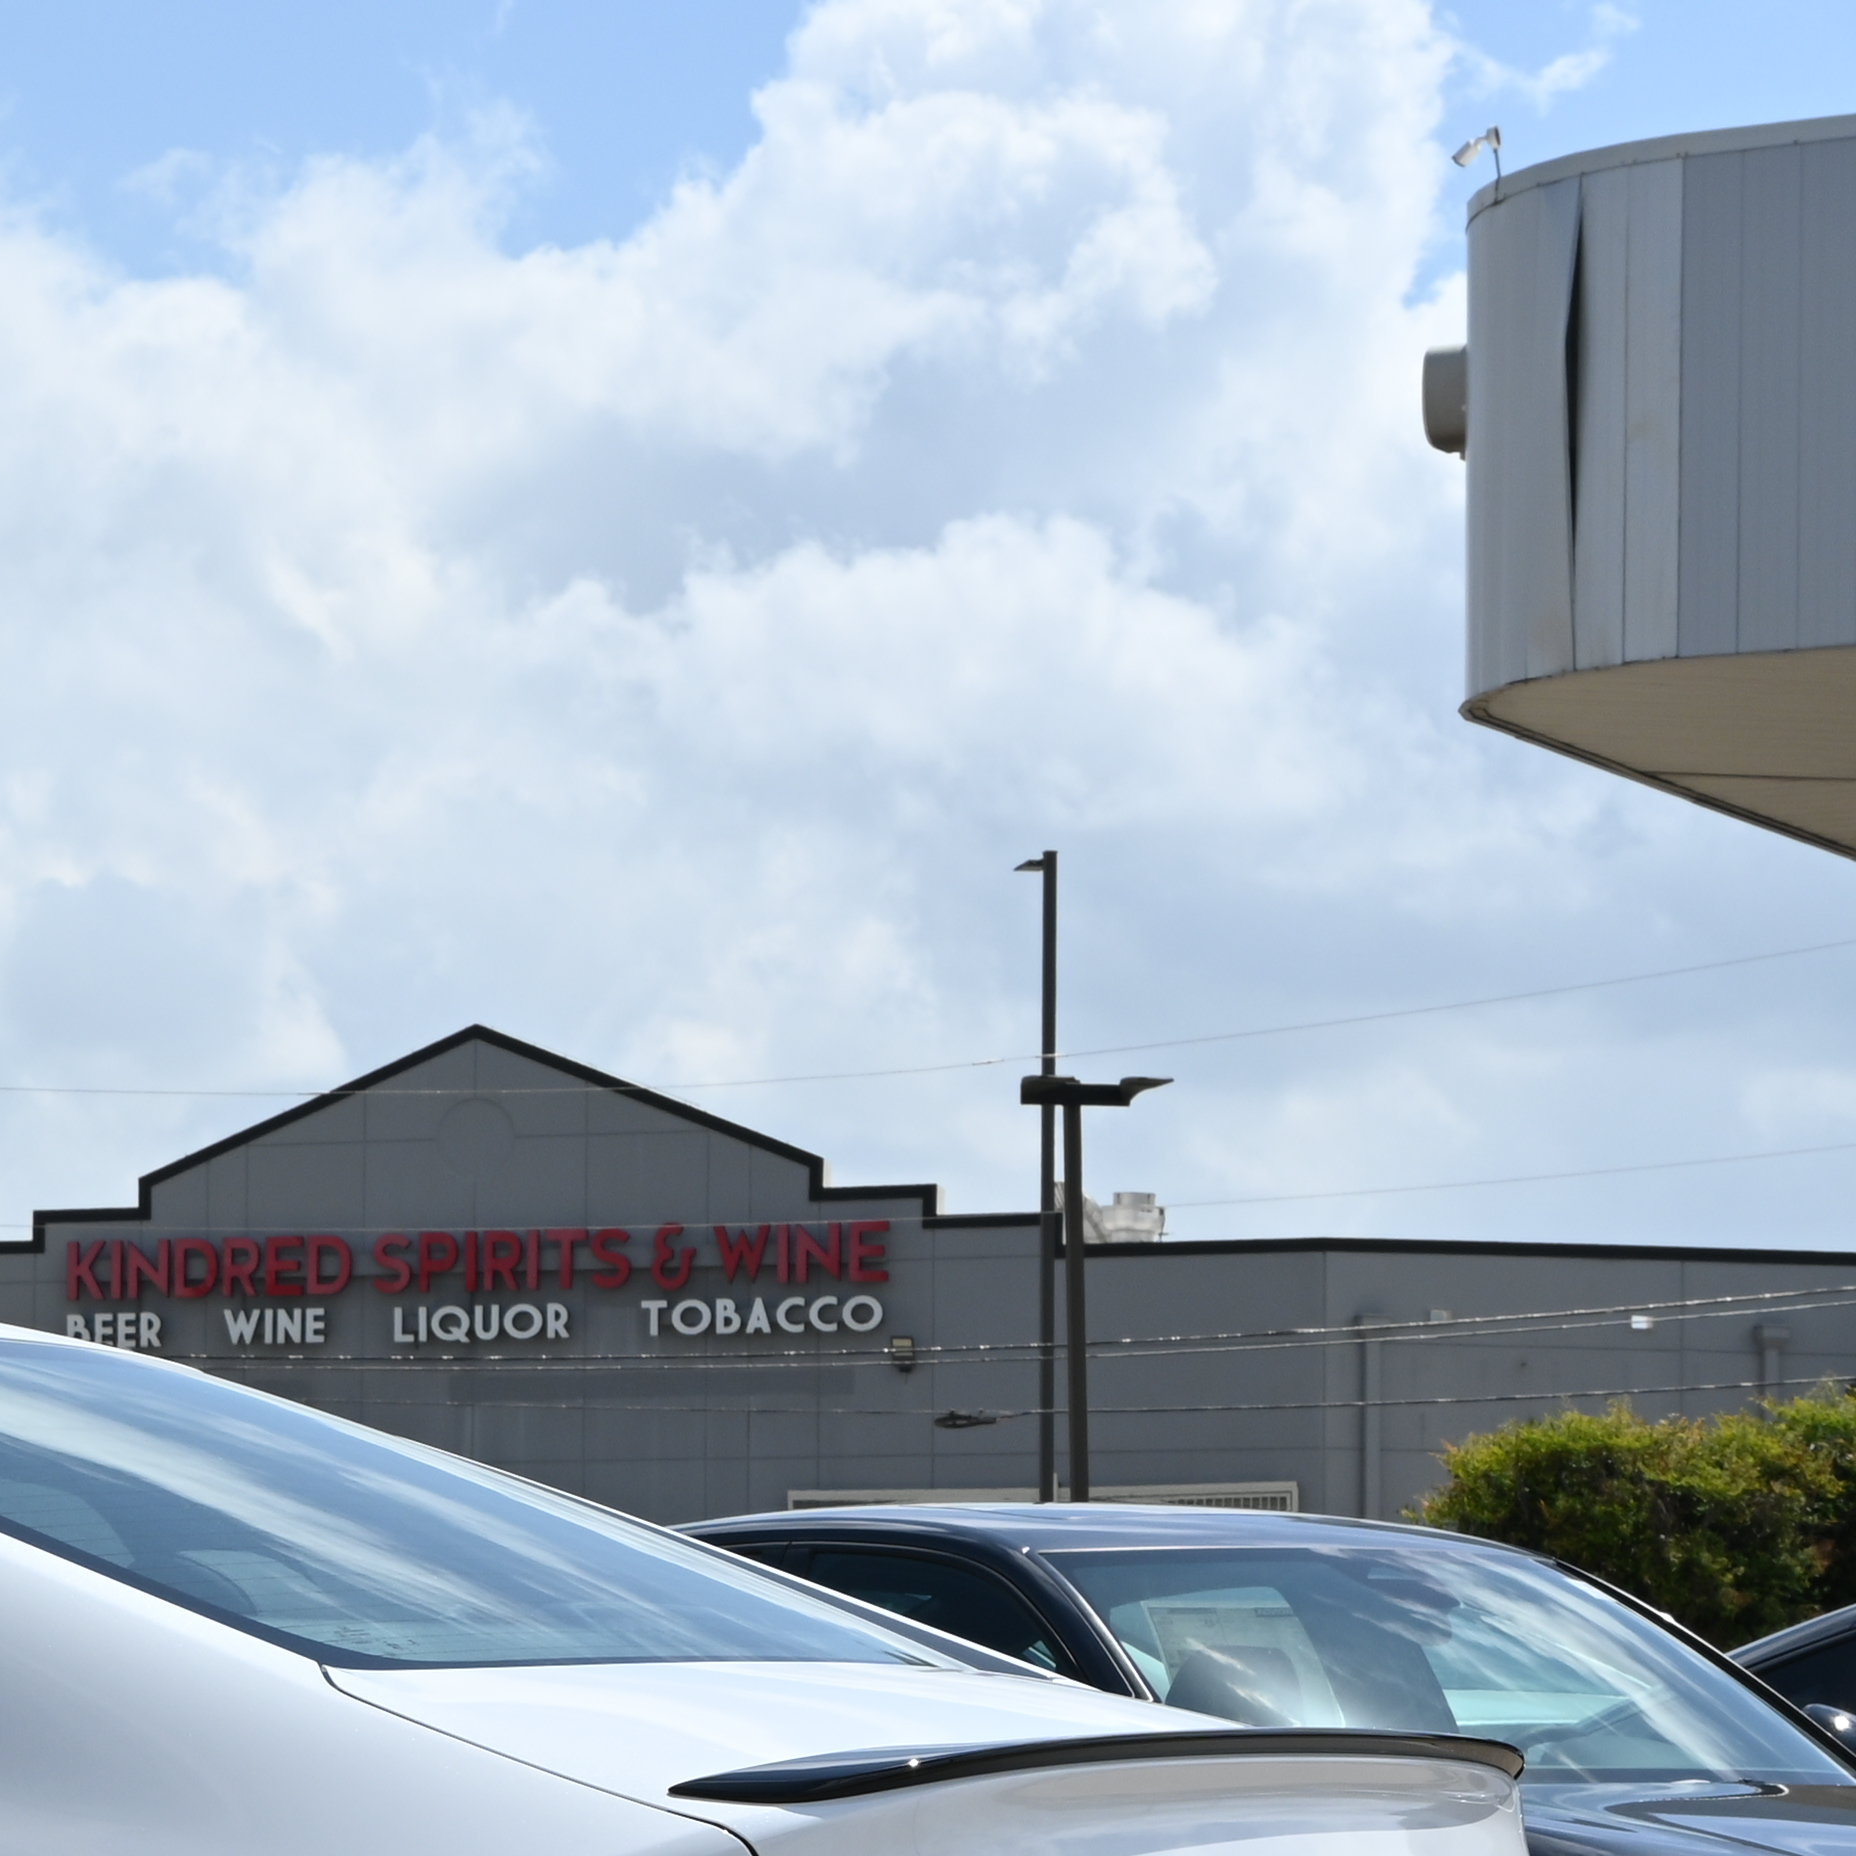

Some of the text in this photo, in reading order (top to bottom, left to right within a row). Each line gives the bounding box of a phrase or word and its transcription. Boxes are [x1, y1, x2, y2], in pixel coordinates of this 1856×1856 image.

[66, 1221, 890, 1300] KINDRED SPIRITS & WINE
[66, 1296, 884, 1348] BEER WINE LIQUOR TOBACCO
